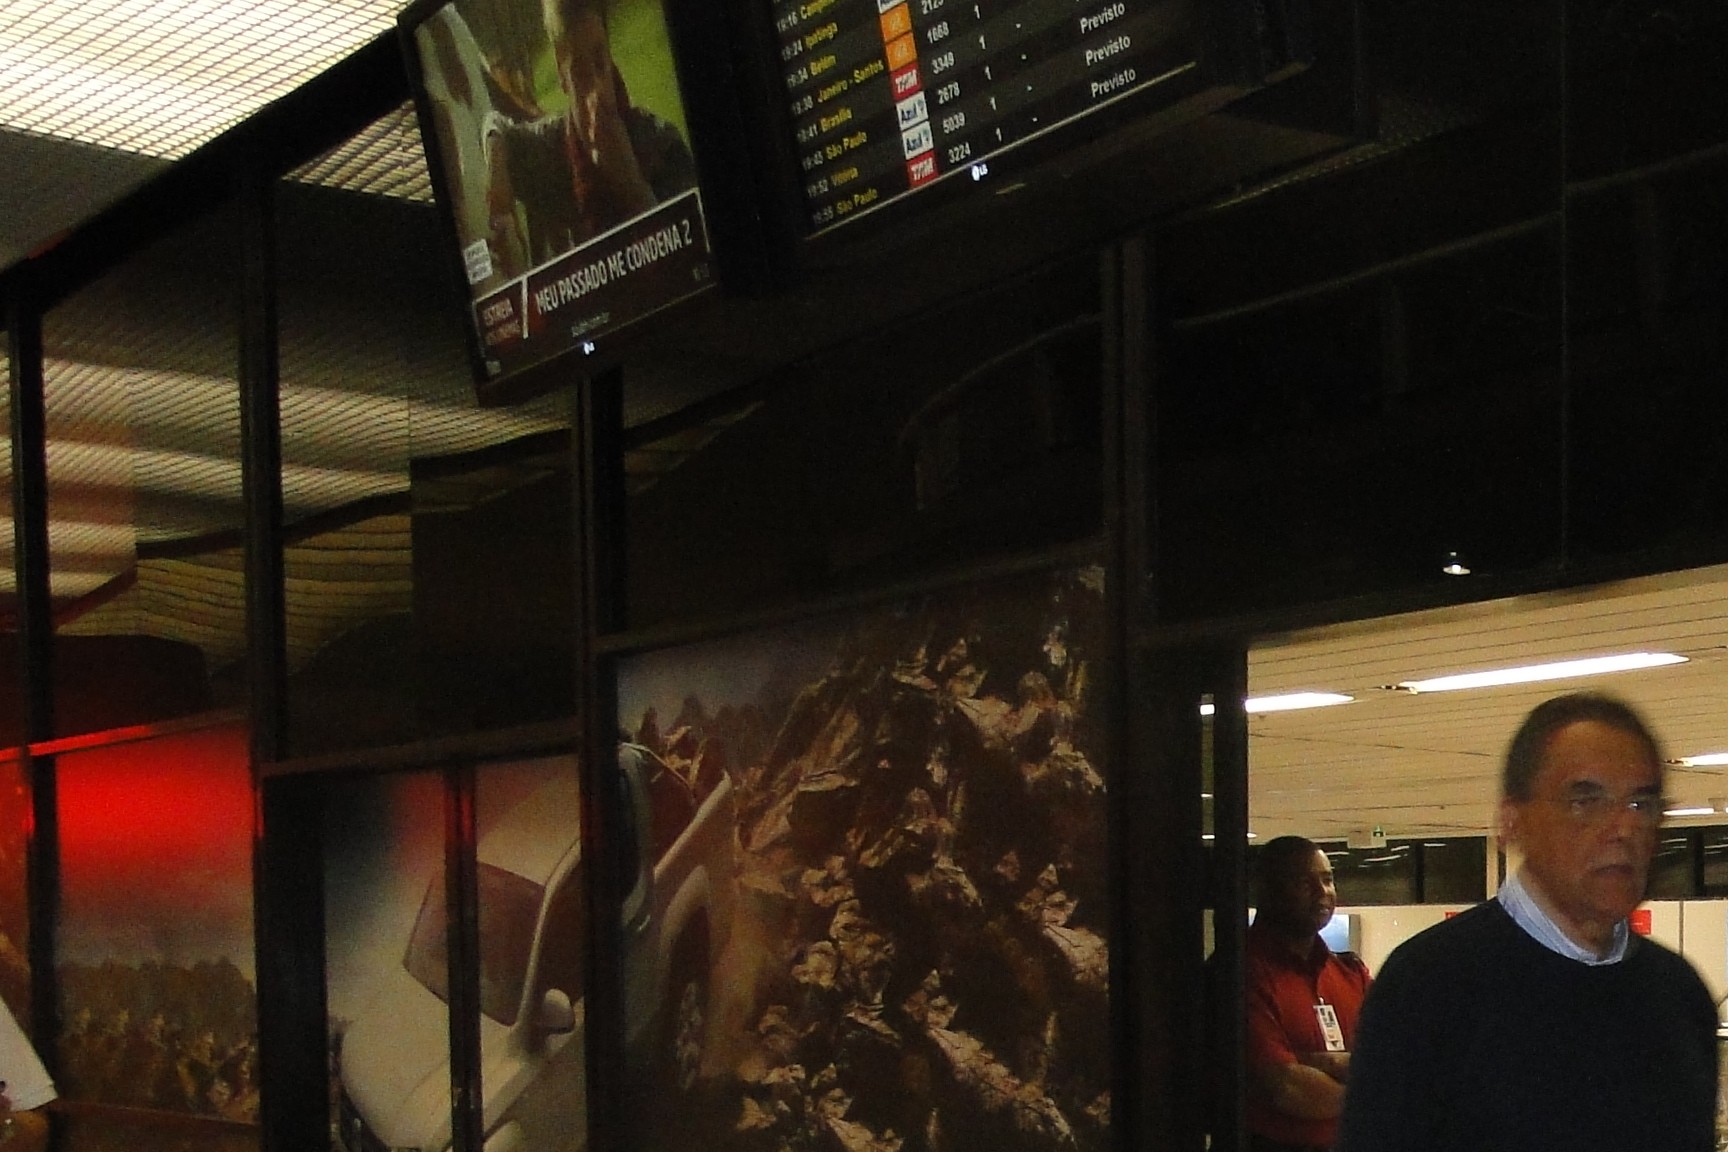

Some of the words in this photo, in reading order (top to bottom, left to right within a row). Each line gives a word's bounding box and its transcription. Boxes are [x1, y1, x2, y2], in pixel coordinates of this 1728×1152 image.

[973, 4, 981, 20] 1
[978, 35, 986, 50] 1
[984, 65, 992, 81] 1
[1079, 1, 1126, 34] Previsto
[989, 96, 997, 111] 1
[1085, 34, 1132, 67] Previsto
[948, 141, 971, 165] 3224
[995, 127, 1003, 142] 1
[1090, 67, 1137, 98] Previsto
[534, 284, 559, 315] MEU
[558, 260, 608, 305] PASSADO
[607, 250, 627, 281] ME
[626, 224, 683, 271] CONDENA
[682, 219, 693, 245] 2
